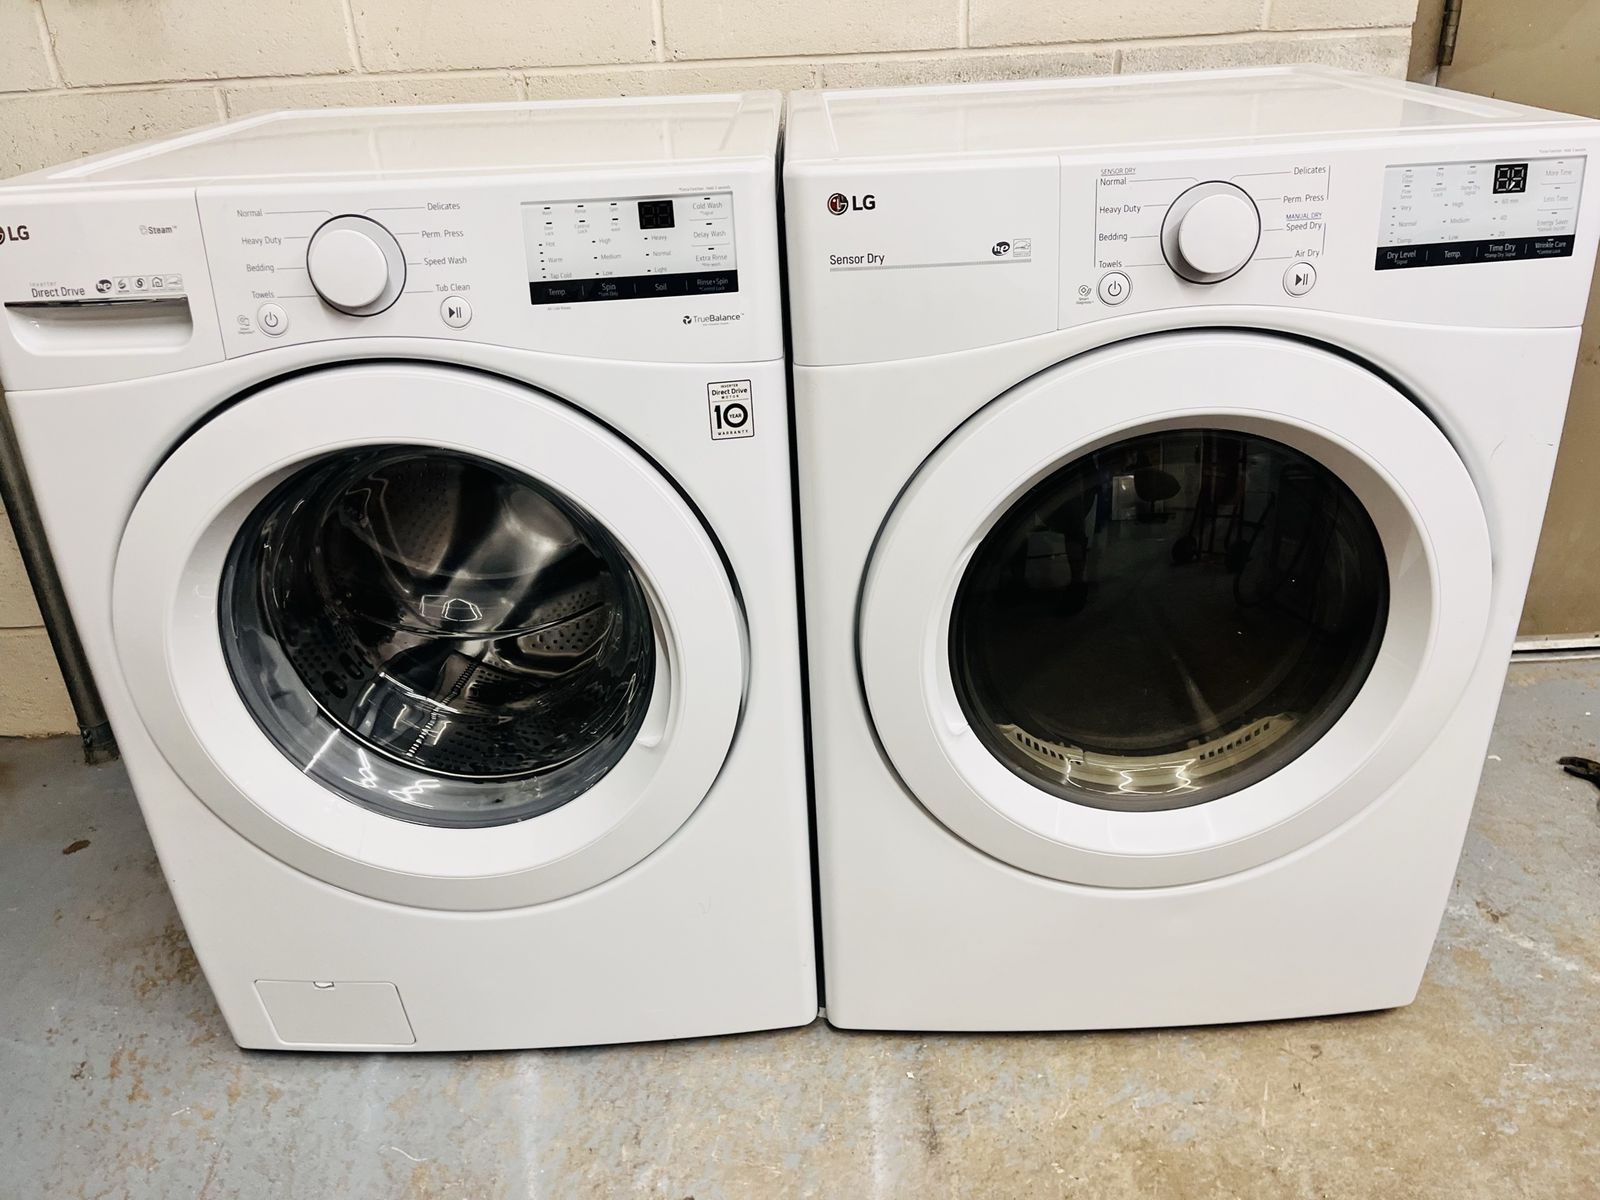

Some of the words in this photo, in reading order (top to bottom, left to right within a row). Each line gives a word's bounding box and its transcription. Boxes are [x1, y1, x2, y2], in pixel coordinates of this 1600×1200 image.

[1100, 167, 1123, 175] SENSOR
[1293, 166, 1326, 175] Delicates
[1100, 177, 1127, 186] Normal
[852, 194, 876, 211] LG
[1305, 194, 1325, 202] Press
[427, 202, 460, 211] Delicates
[1099, 205, 1121, 215] Heavy
[1123, 204, 1141, 214] Duty
[237, 209, 263, 217] Normal
[1286, 223, 1307, 232] Speed
[1309, 222, 1322, 231] Dry
[9, 225, 29, 241] LG
[421, 230, 442, 239] Perm.
[444, 229, 464, 238] Press
[693, 230, 709, 239] Delay
[1099, 232, 1128, 242] Bedding
[241, 236, 263, 246] Heavy
[264, 236, 282, 245] Duty
[1489, 244, 1502, 252] Time
[1503, 243, 1516, 253] Dry
[695, 254, 710, 262] Extra
[711, 253, 727, 261] Rinse
[1306, 249, 1320, 258] Dry
[1387, 252, 1399, 260] Dry
[1400, 250, 1416, 258] Level
[424, 257, 446, 266] Speed
[447, 256, 467, 265] Wash
[829, 254, 864, 265] Sensor
[867, 253, 885, 265] Dry
[246, 263, 274, 273] Bedding
[1099, 260, 1122, 268] Towels
[436, 284, 449, 292] Tub
[451, 283, 470, 291] Clean
[602, 283, 616, 292] Spin
[655, 283, 667, 291] Soil
[31, 286, 59, 298] Direct
[61, 286, 86, 297] Drive
[252, 291, 274, 299] Towels
[714, 403, 748, 429] 10
